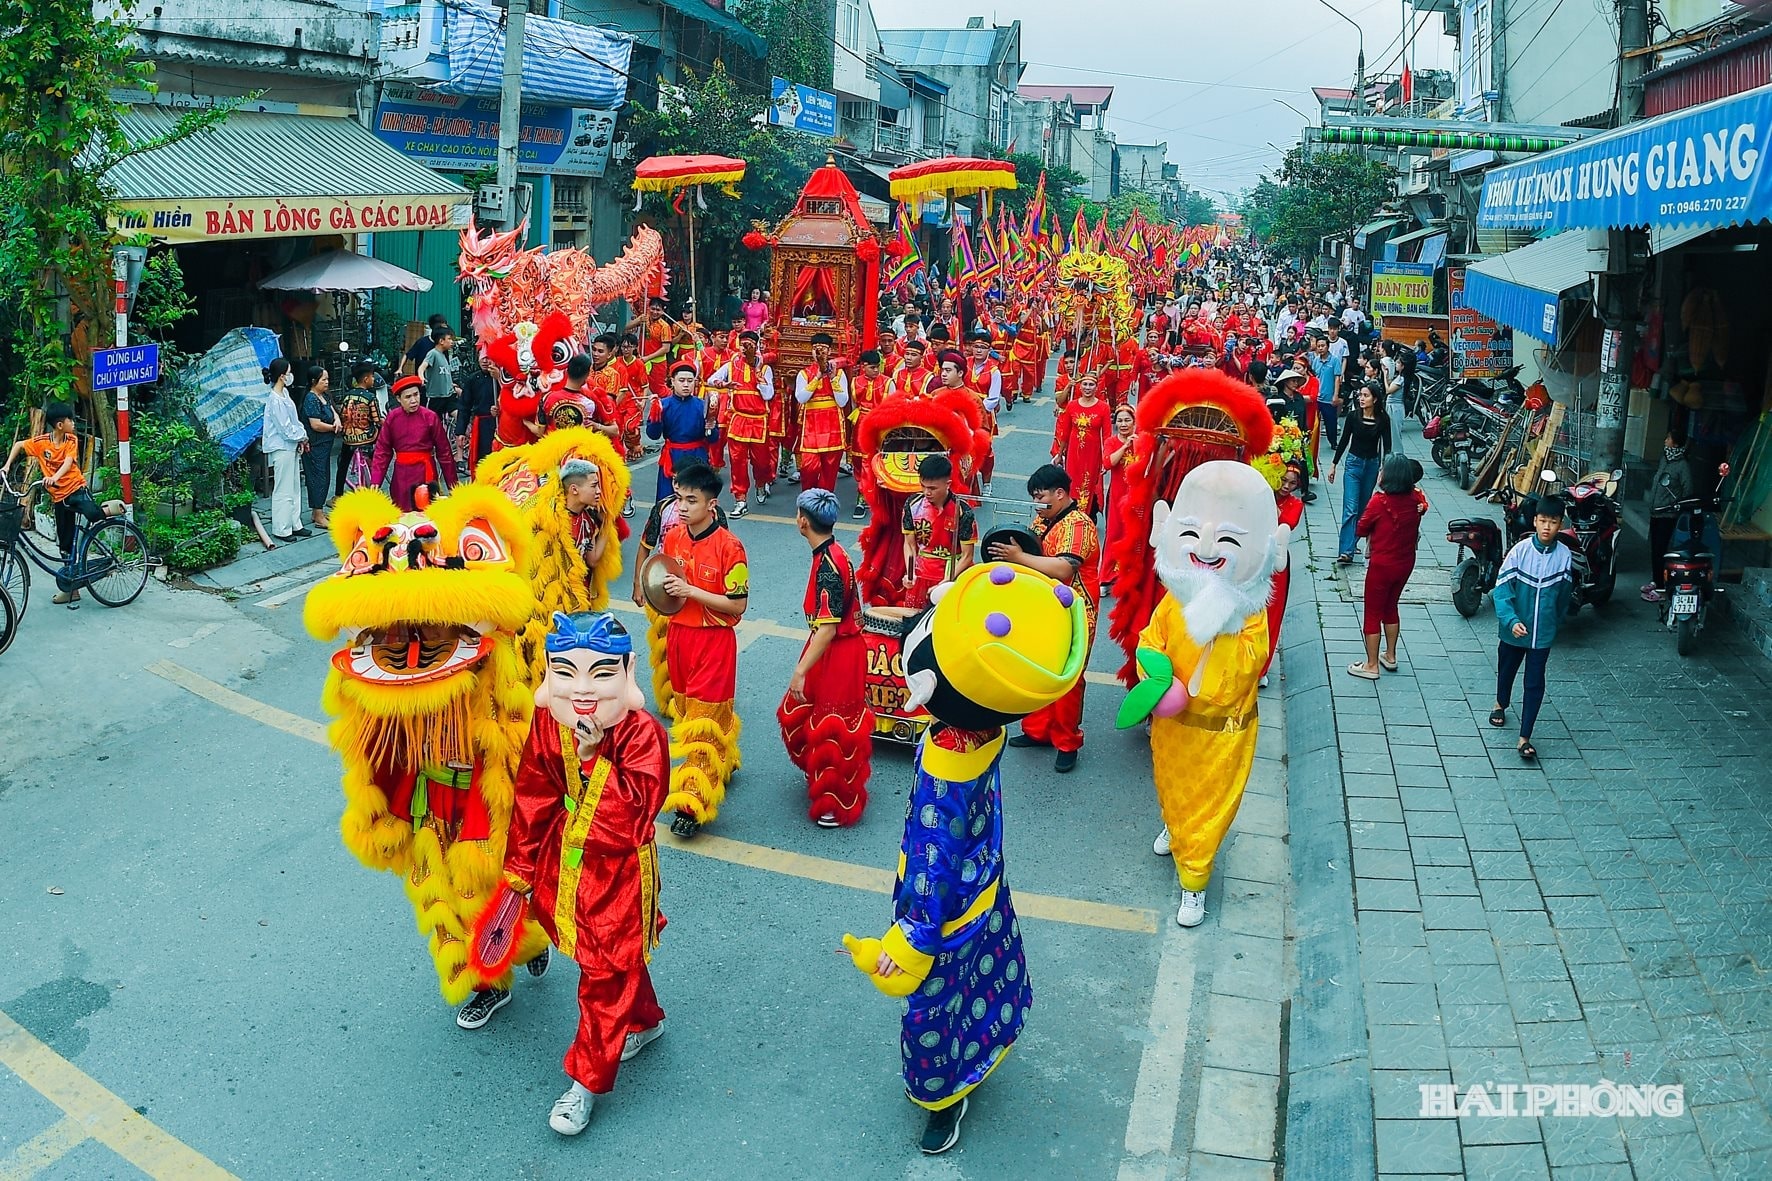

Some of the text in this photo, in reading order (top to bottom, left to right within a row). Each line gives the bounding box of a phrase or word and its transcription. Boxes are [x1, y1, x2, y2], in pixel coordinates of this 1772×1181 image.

[380, 112, 402, 131] NINH
[401, 113, 428, 134] GIANG
[404, 141, 416, 151] XE
[416, 142, 440, 154] CHẠY
[441, 144, 460, 154] CAO
[1485, 171, 1516, 208] NHÔM
[1533, 167, 1574, 205] INOX
[1645, 123, 1759, 192] GIANG
[1660, 197, 1747, 215] ĐT: 0946.270 227
[153, 205, 192, 228] Hiền
[205, 202, 254, 235] BÁN
[264, 199, 321, 233] LỒNG
[329, 199, 356, 230] GÀ
[361, 199, 400, 228] CÁC
[405, 204, 448, 230] LOẠI
[1375, 278, 1401, 297] BÀN
[1404, 280, 1430, 299] THỜ
[107, 350, 144, 366] DỪNG LẠI
[96, 364, 153, 386] CHÚ Ý QUAN SÁT
